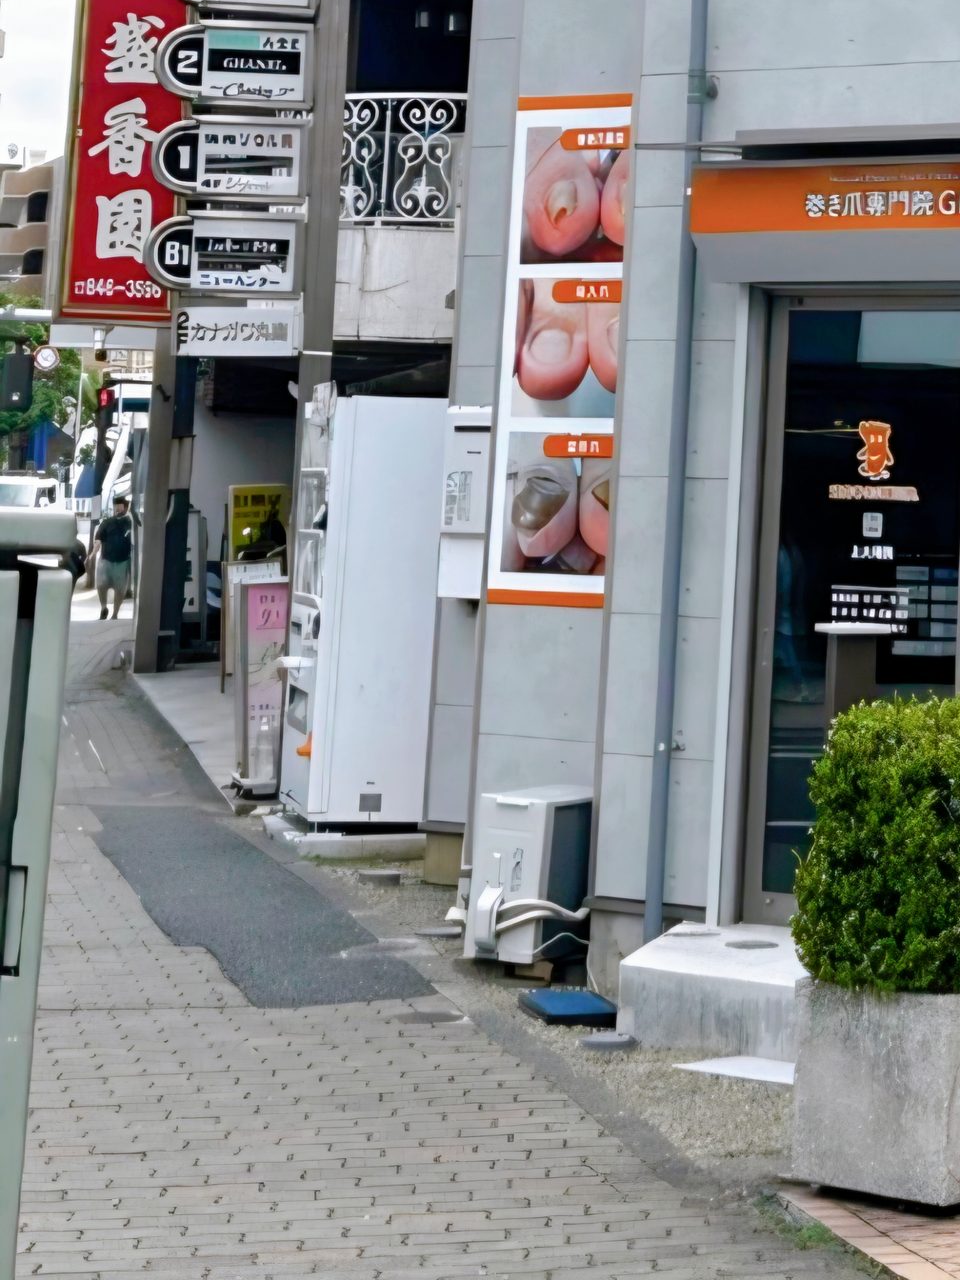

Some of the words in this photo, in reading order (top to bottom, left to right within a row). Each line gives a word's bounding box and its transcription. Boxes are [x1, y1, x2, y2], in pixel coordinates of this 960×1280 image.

[177, 50, 198, 73] 2
[178, 146, 191, 169] 1
[165, 241, 190, 266] B1
